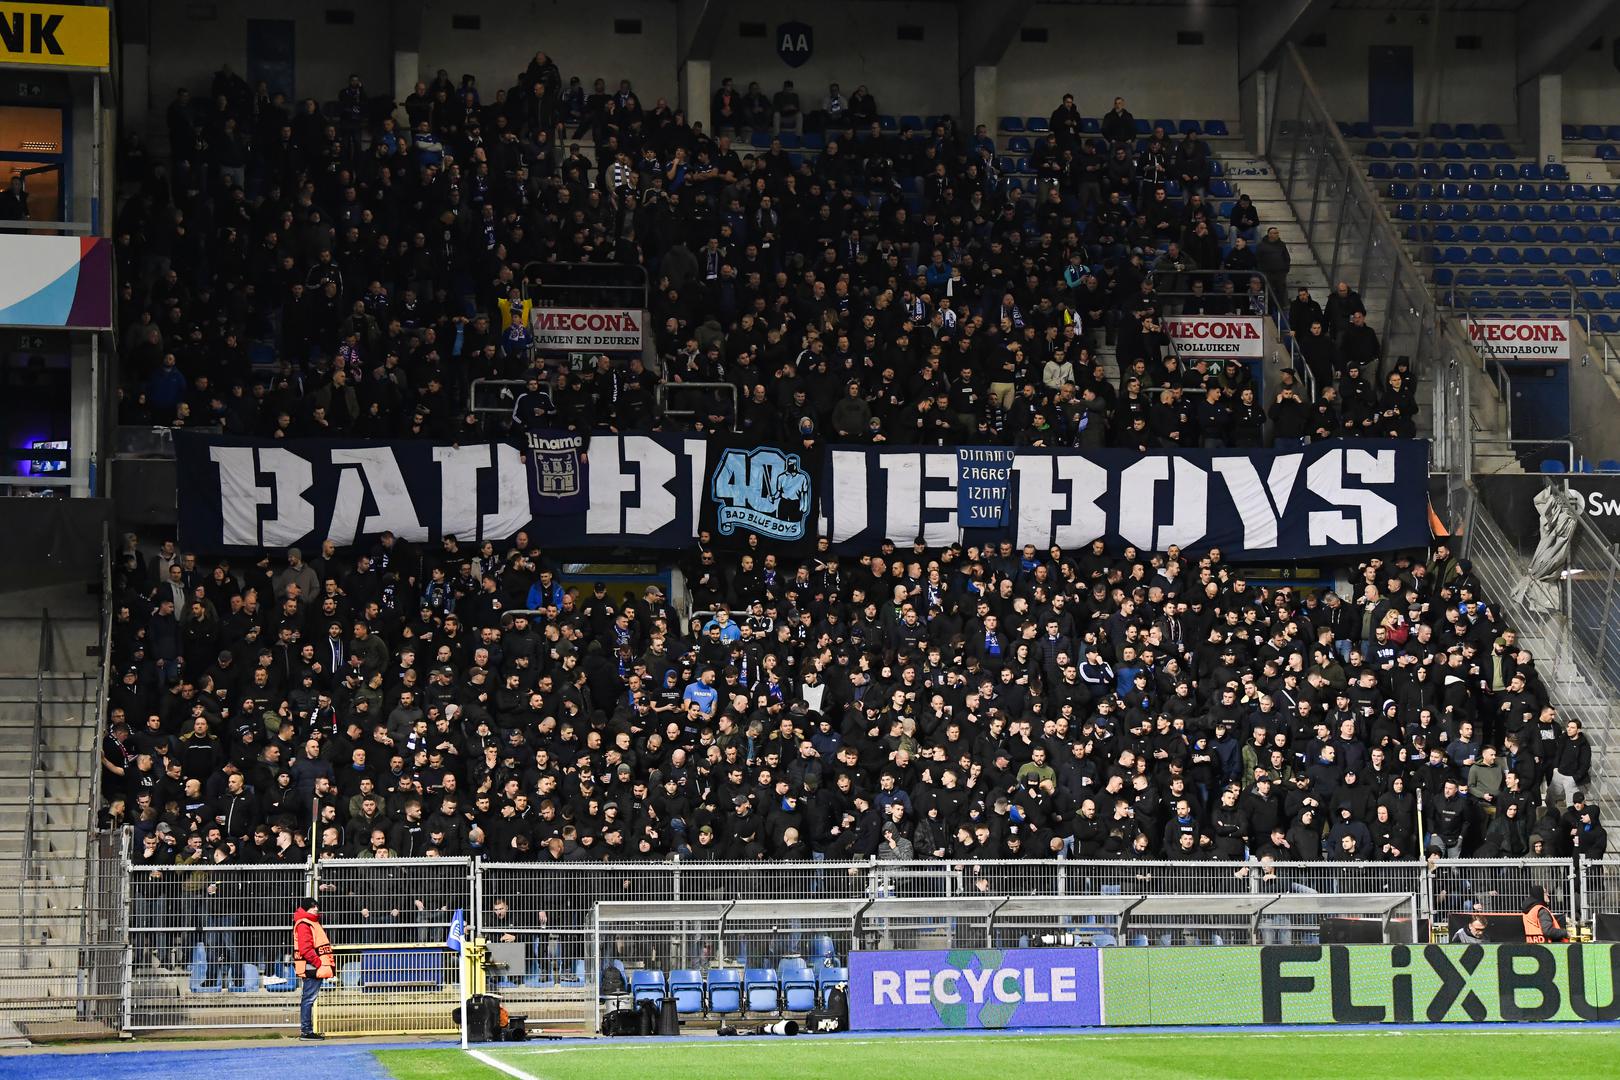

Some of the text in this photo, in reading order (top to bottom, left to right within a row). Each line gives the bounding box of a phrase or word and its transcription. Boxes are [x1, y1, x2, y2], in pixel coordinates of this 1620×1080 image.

[0, 11, 64, 55] NK
[782, 33, 808, 51] AA
[534, 312, 640, 332] MECONA
[1161, 321, 1260, 339] MECONA
[534, 335, 573, 344] RAMEN
[576, 336, 591, 344] EN
[594, 336, 640, 345] DEUREN
[1468, 324, 1567, 341] MECONA
[1176, 343, 1240, 352] ROLLUIKEN
[1473, 345, 1559, 354] VERANDABOUW
[960, 448, 1015, 462] DINAMO
[716, 450, 786, 514] 40
[209, 443, 532, 548] BAD
[1012, 448, 1398, 552] BOYS
[725, 510, 798, 534] BAD BLUE BOYS
[873, 966, 1077, 1006] RECYCLE
